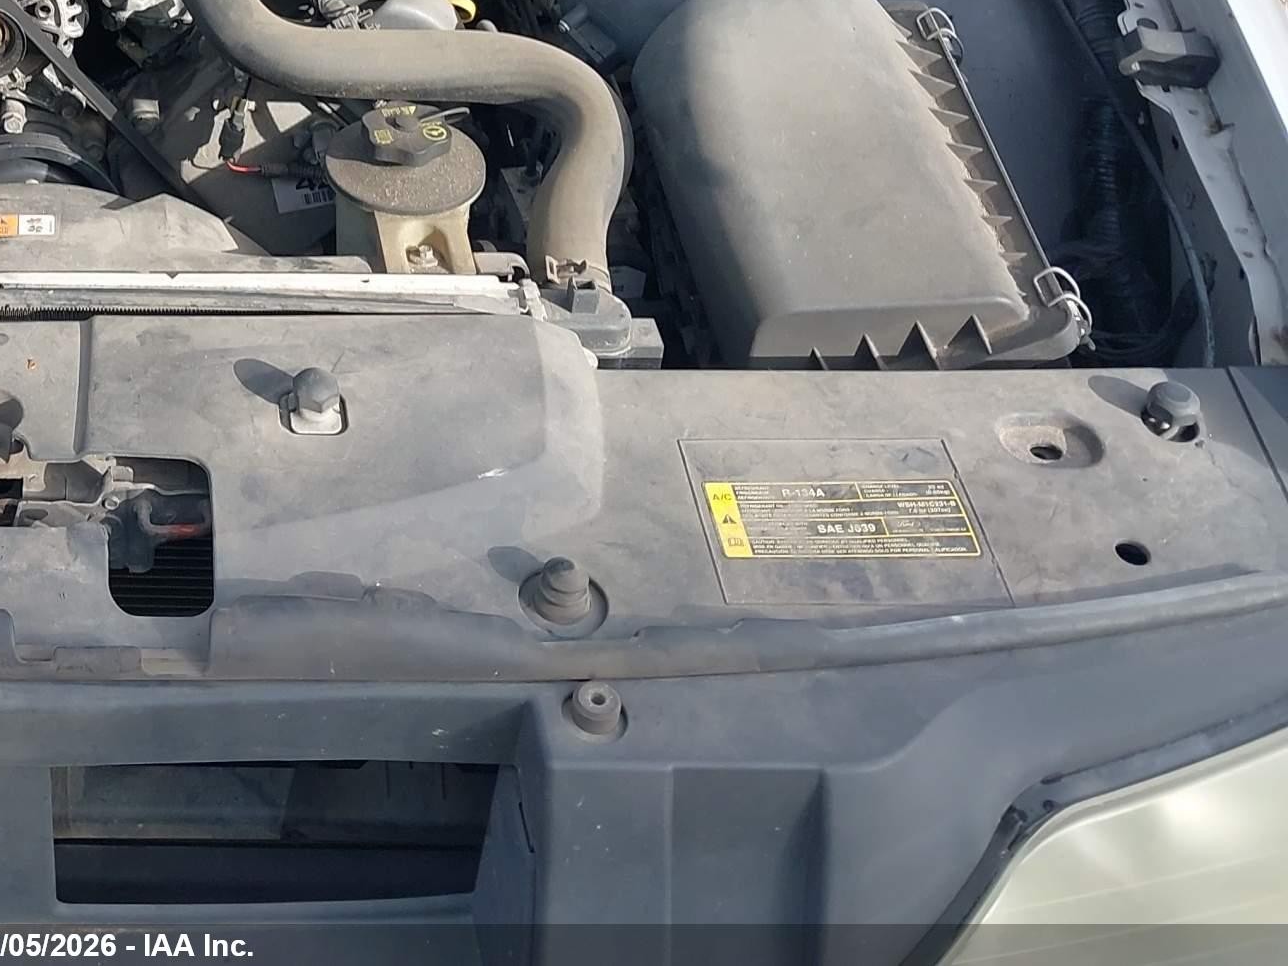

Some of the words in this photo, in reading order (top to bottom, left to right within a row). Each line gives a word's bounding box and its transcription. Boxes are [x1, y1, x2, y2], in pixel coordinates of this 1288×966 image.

[712, 492, 732, 501] A/C
[781, 487, 826, 499] R-134A
[817, 523, 845, 534] SAE
